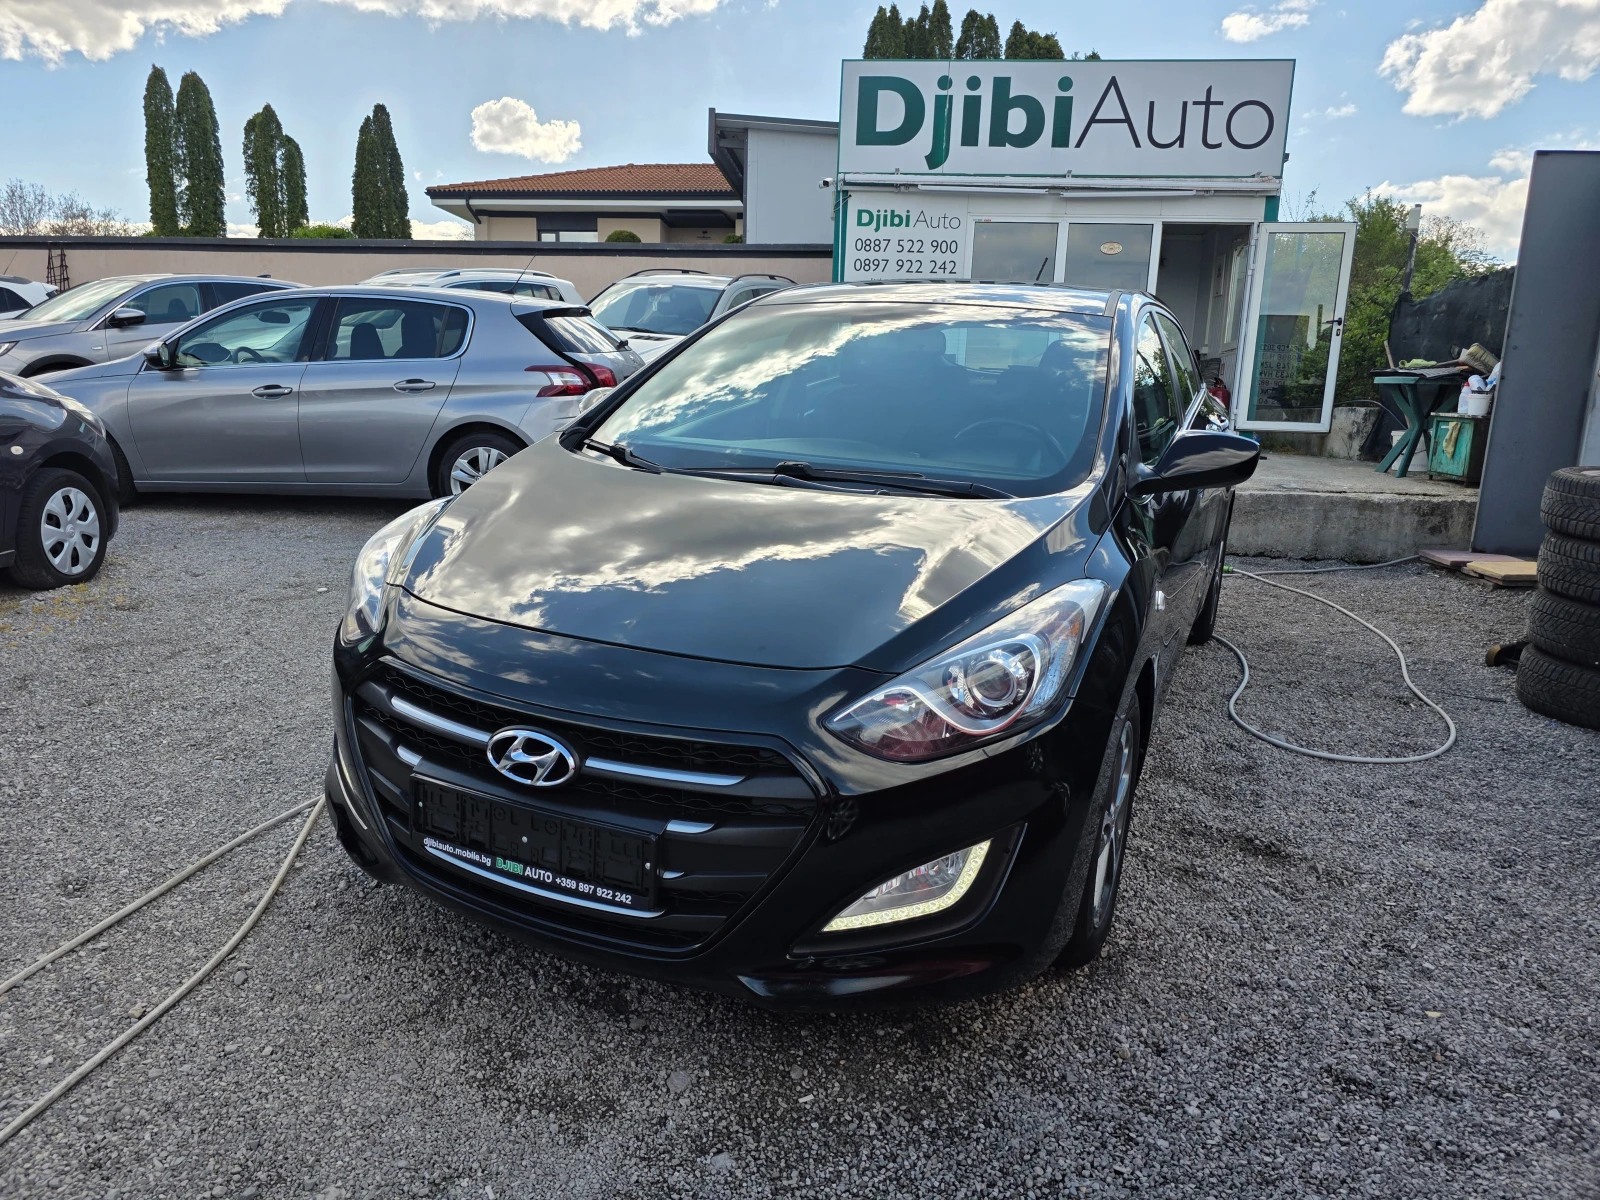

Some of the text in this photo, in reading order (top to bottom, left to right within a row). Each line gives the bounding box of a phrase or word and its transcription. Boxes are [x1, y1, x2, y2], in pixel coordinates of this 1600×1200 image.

[854, 238, 958, 255] 0887 522 900
[853, 258, 957, 276] 0897 922 242
[423, 836, 632, 905] djibiauto.mobile.bg DJIBI AUTO +359 897 922 242
